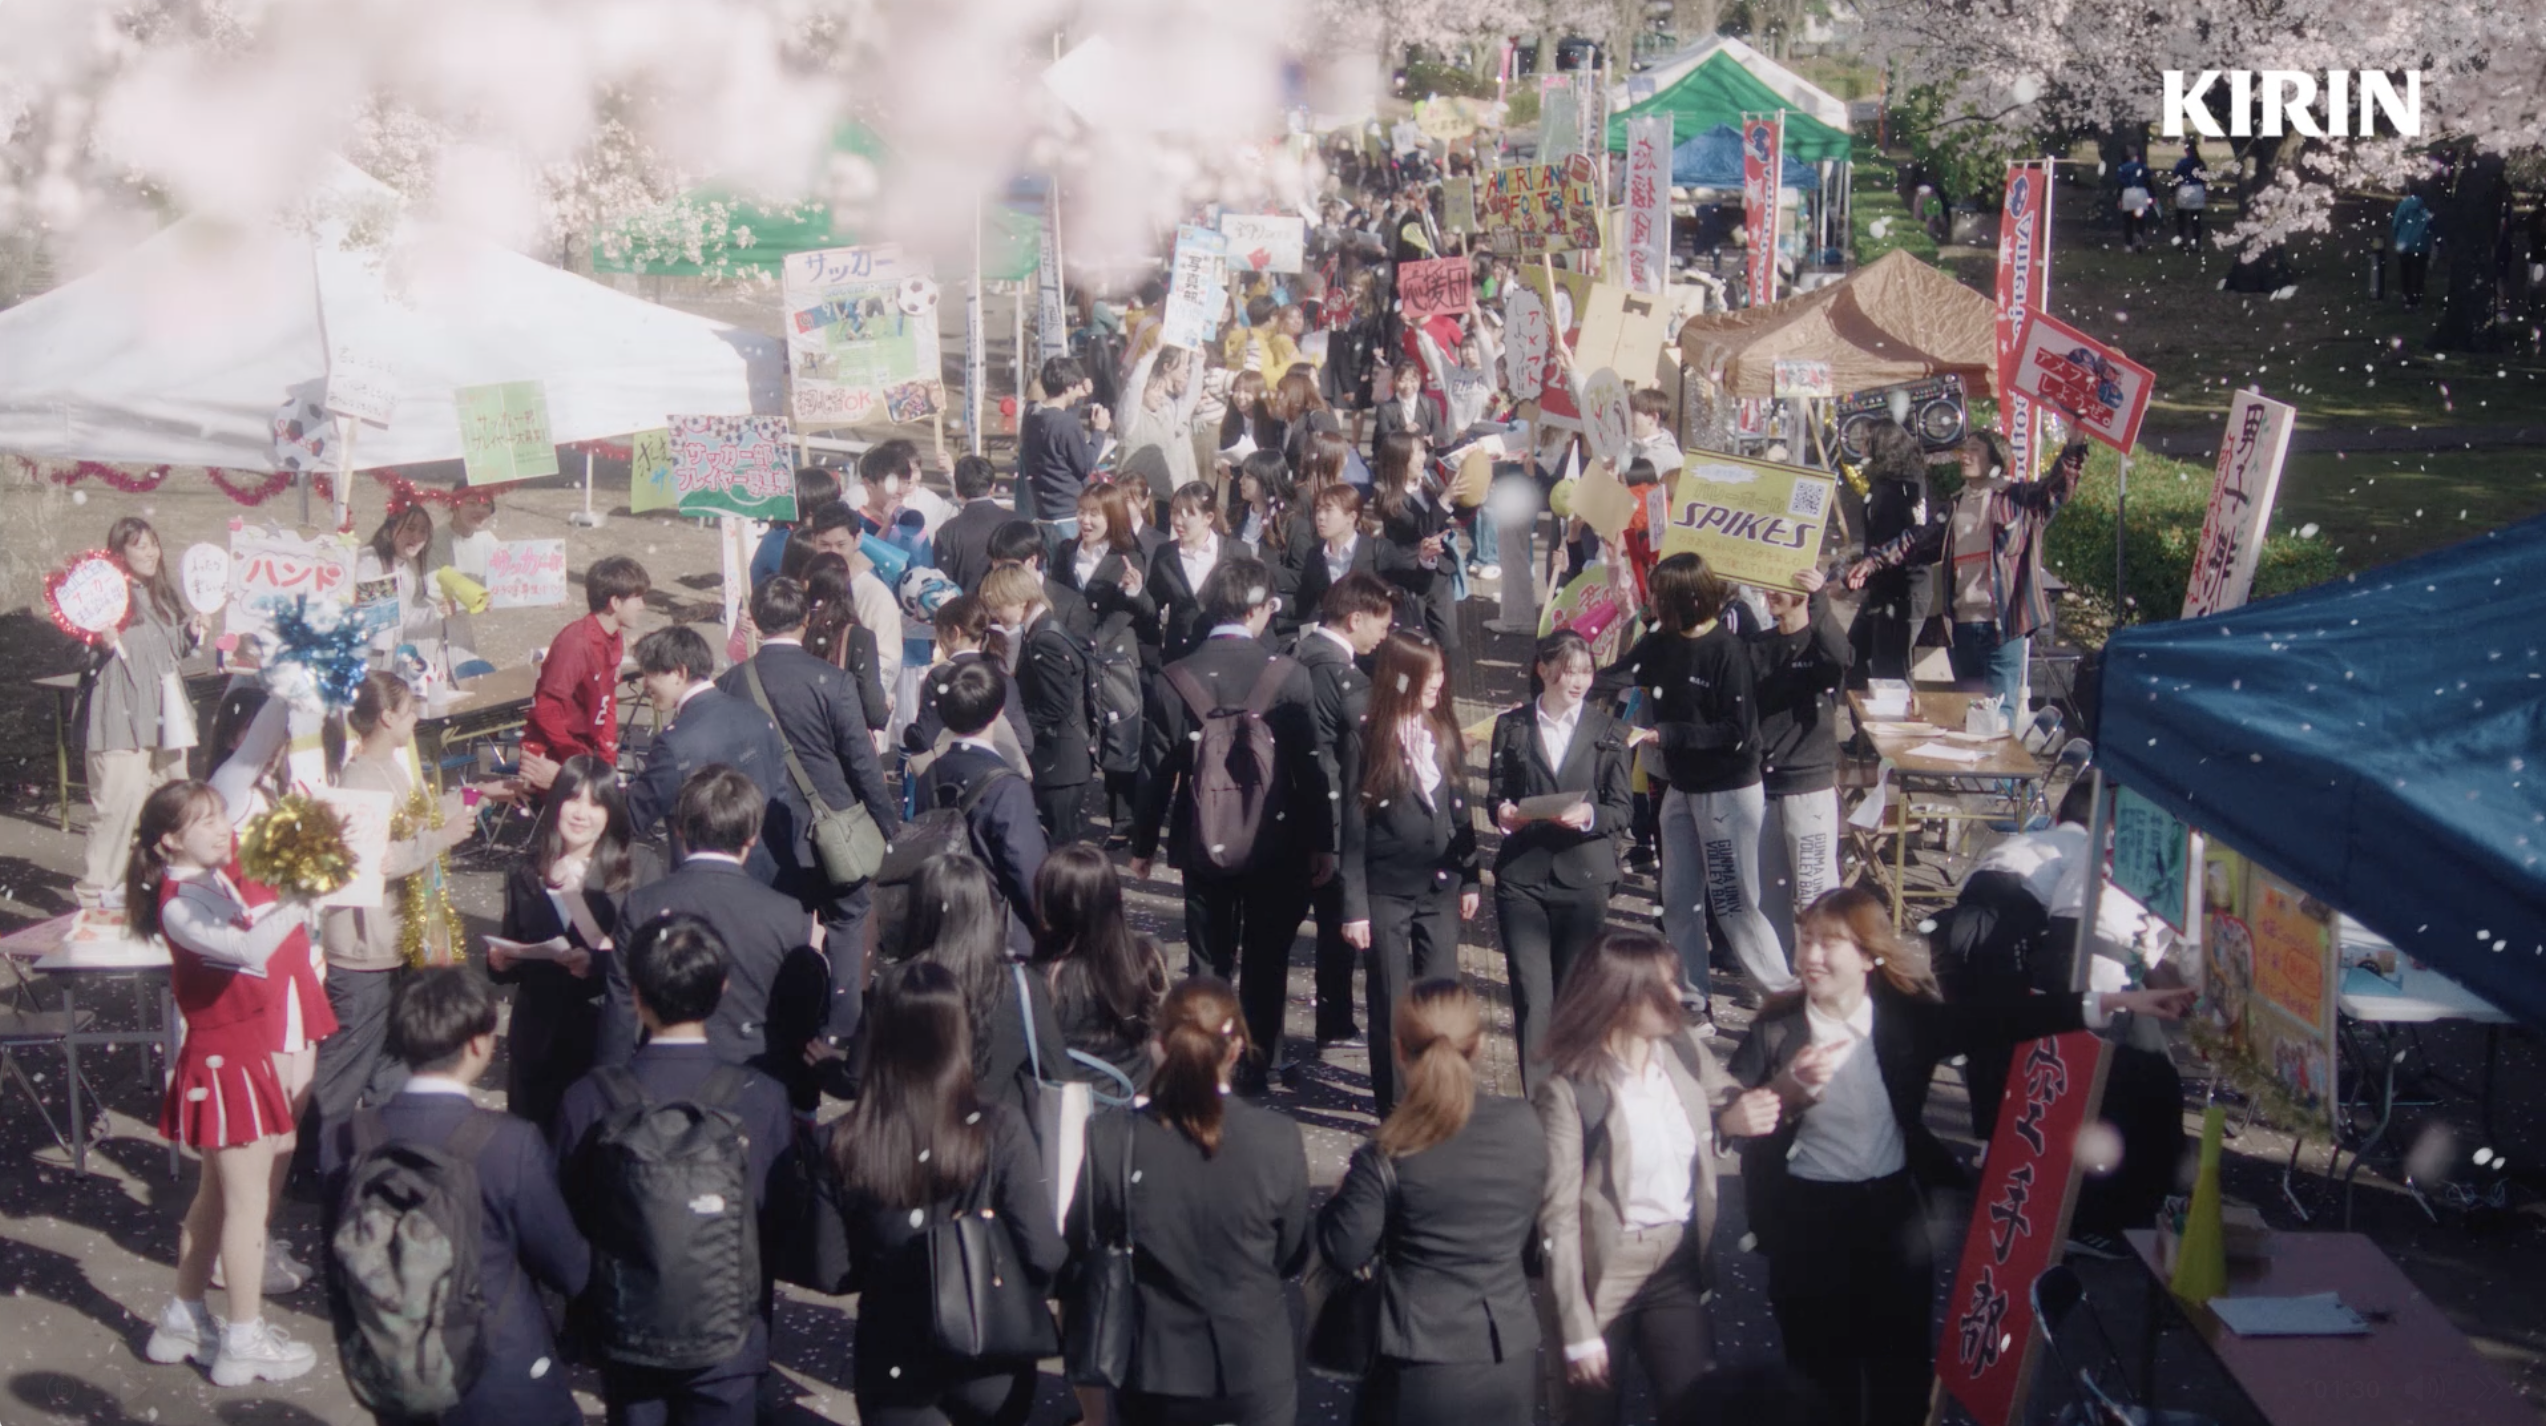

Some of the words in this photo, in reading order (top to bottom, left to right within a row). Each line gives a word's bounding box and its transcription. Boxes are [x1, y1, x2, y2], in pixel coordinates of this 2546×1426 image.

[1486, 165, 1562, 198] AMERICAN
[1510, 187, 1593, 215] FOOTBALL
[805, 251, 895, 283] サッカー
[1183, 253, 1206, 306] 写真部
[1403, 266, 1468, 310] 応援団
[1527, 311, 1541, 387] アメフト
[2037, 350, 2101, 395] アメフト
[685, 442, 776, 472] サッカー部
[675, 465, 792, 497] プレイヤー募集中
[1694, 483, 1785, 514] バレーボール
[1673, 502, 1817, 549] SPIKES
[245, 559, 342, 592] ハンド
[1705, 840, 1724, 886] VOLLEY
[1718, 839, 1736, 883] GUNMA
[1798, 834, 1815, 878] VOLLEY
[1813, 833, 1828, 876] GUNMA
[1959, 1034, 2068, 1379] 空手部
